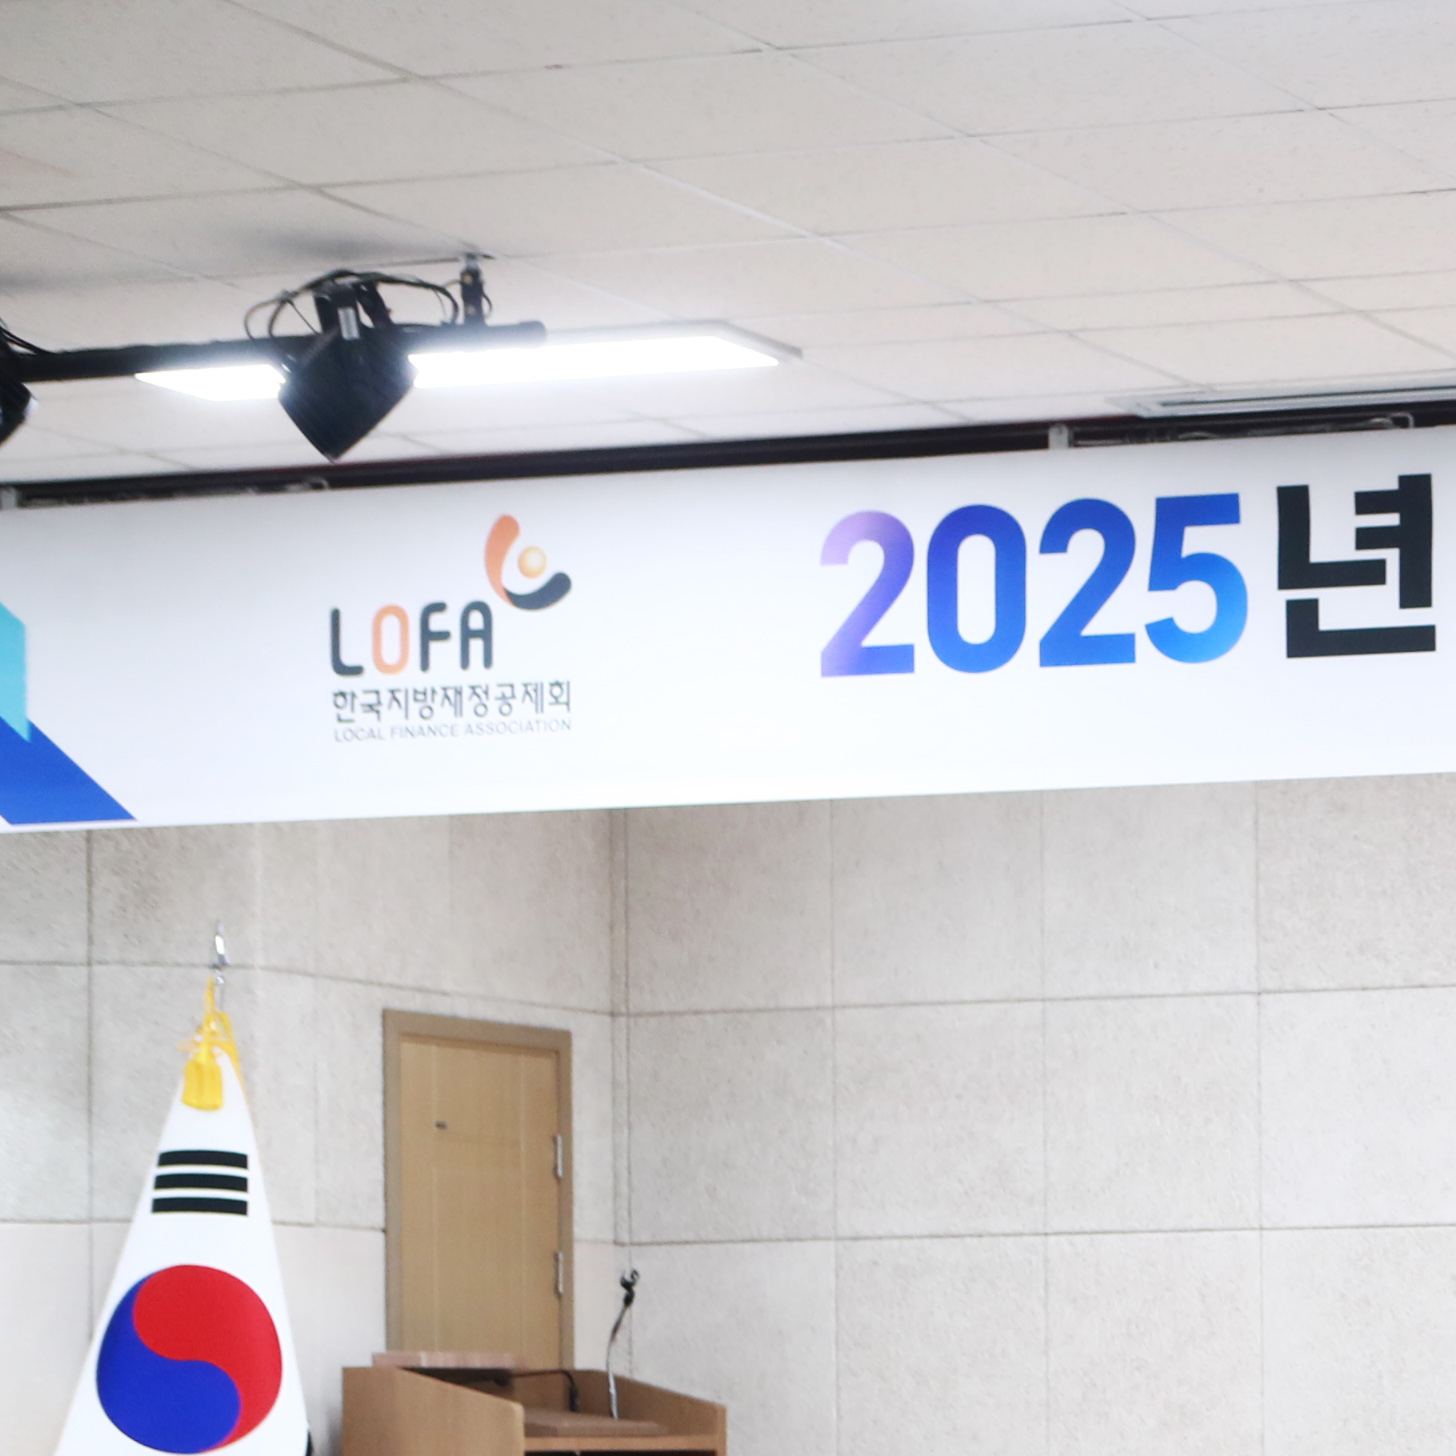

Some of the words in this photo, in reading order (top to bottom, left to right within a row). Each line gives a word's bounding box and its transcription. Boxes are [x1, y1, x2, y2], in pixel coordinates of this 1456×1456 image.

[820, 472, 1437, 677] 2025년
[329, 600, 493, 677] LOFA
[333, 680, 571, 723] 한국지방재정공제회
[334, 727, 385, 742] LOCAL
[390, 723, 459, 739] FINANCE
[464, 718, 572, 736] ASSOCIATION
